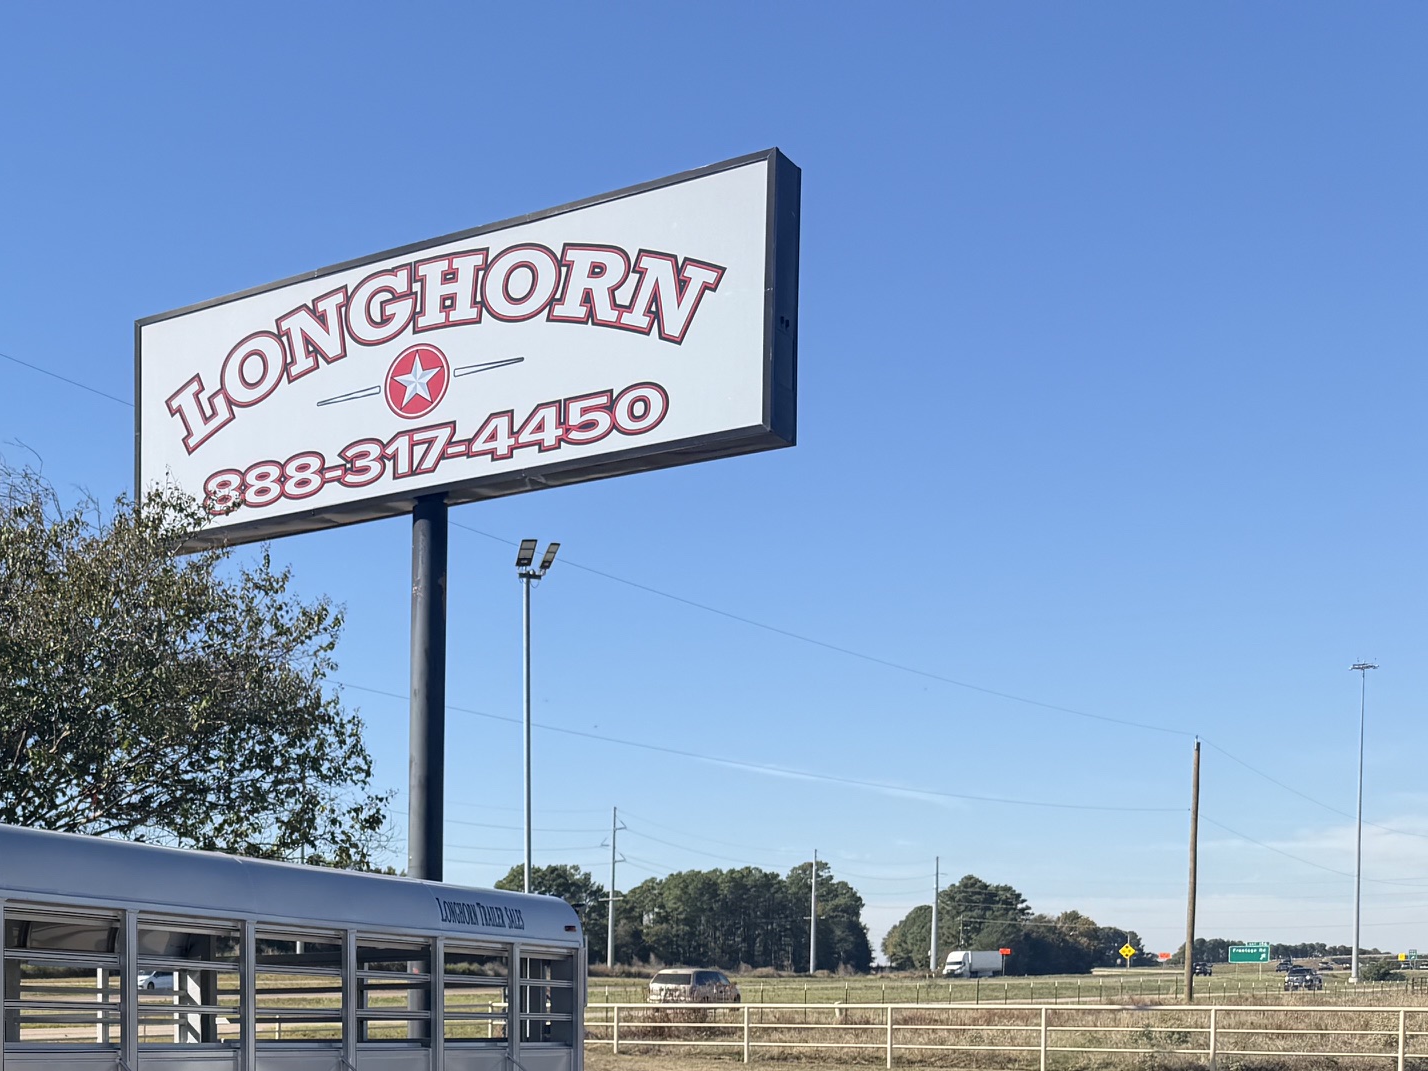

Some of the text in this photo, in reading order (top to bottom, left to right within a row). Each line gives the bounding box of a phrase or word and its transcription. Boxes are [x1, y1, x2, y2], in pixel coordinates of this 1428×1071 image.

[165, 242, 727, 455] LONGHORN
[203, 381, 670, 516] 888-317-4450
[435, 897, 525, 930] LONGHORN TRAILER SALES
